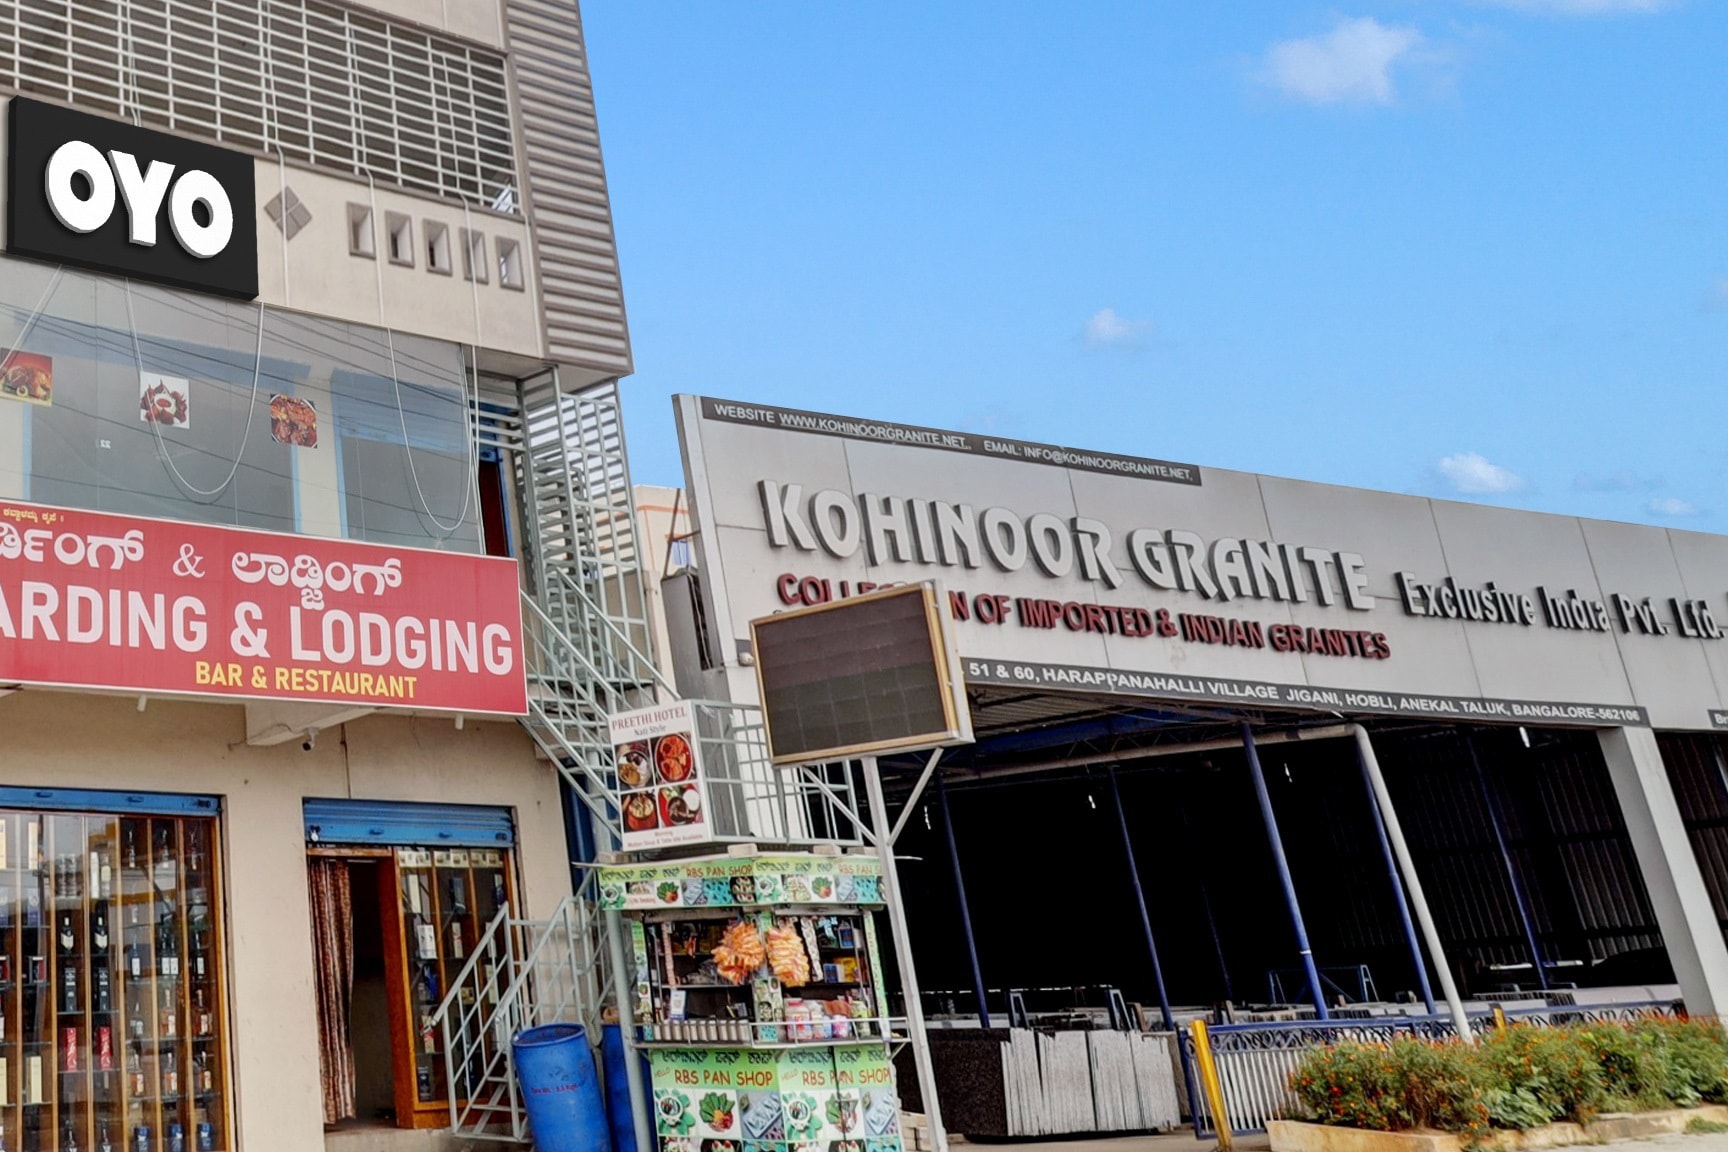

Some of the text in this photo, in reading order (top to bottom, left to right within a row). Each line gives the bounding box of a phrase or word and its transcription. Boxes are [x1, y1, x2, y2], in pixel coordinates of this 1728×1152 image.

[44, 139, 234, 259] OYO
[714, 403, 775, 424] WEBSITE
[983, 440, 1022, 457] EMAIL:
[172, 543, 206, 579] &
[757, 479, 1725, 640] KOHINOOR GRANITE Exclusive India Pvt. Ltd.
[230, 601, 271, 658] &
[290, 605, 514, 676] LODGING
[976, 593, 1012, 624] OF
[1016, 597, 1154, 637] IMPORTED
[1157, 608, 1178, 637] &
[1178, 613, 1266, 649] INDIAN
[1269, 623, 1390, 659] GRANITES
[195, 661, 417, 698] BAR & RESTAURANT
[969, 662, 1640, 723] 51 & 60, HARAPPANAHALLI VILLAGE JIGANI, HOBLI, ANEKAL TALUK, BANGALORE-562106
[612, 706, 688, 730] PREETHI HOTEL
[706, 866, 725, 876] PAN
[728, 865, 752, 875] SHOP
[674, 1069, 699, 1085] RBS
[703, 1069, 731, 1085] PAN
[736, 1070, 773, 1087] SHOP
[802, 1071, 825, 1086] RBS
[859, 1069, 892, 1085] SHOP
